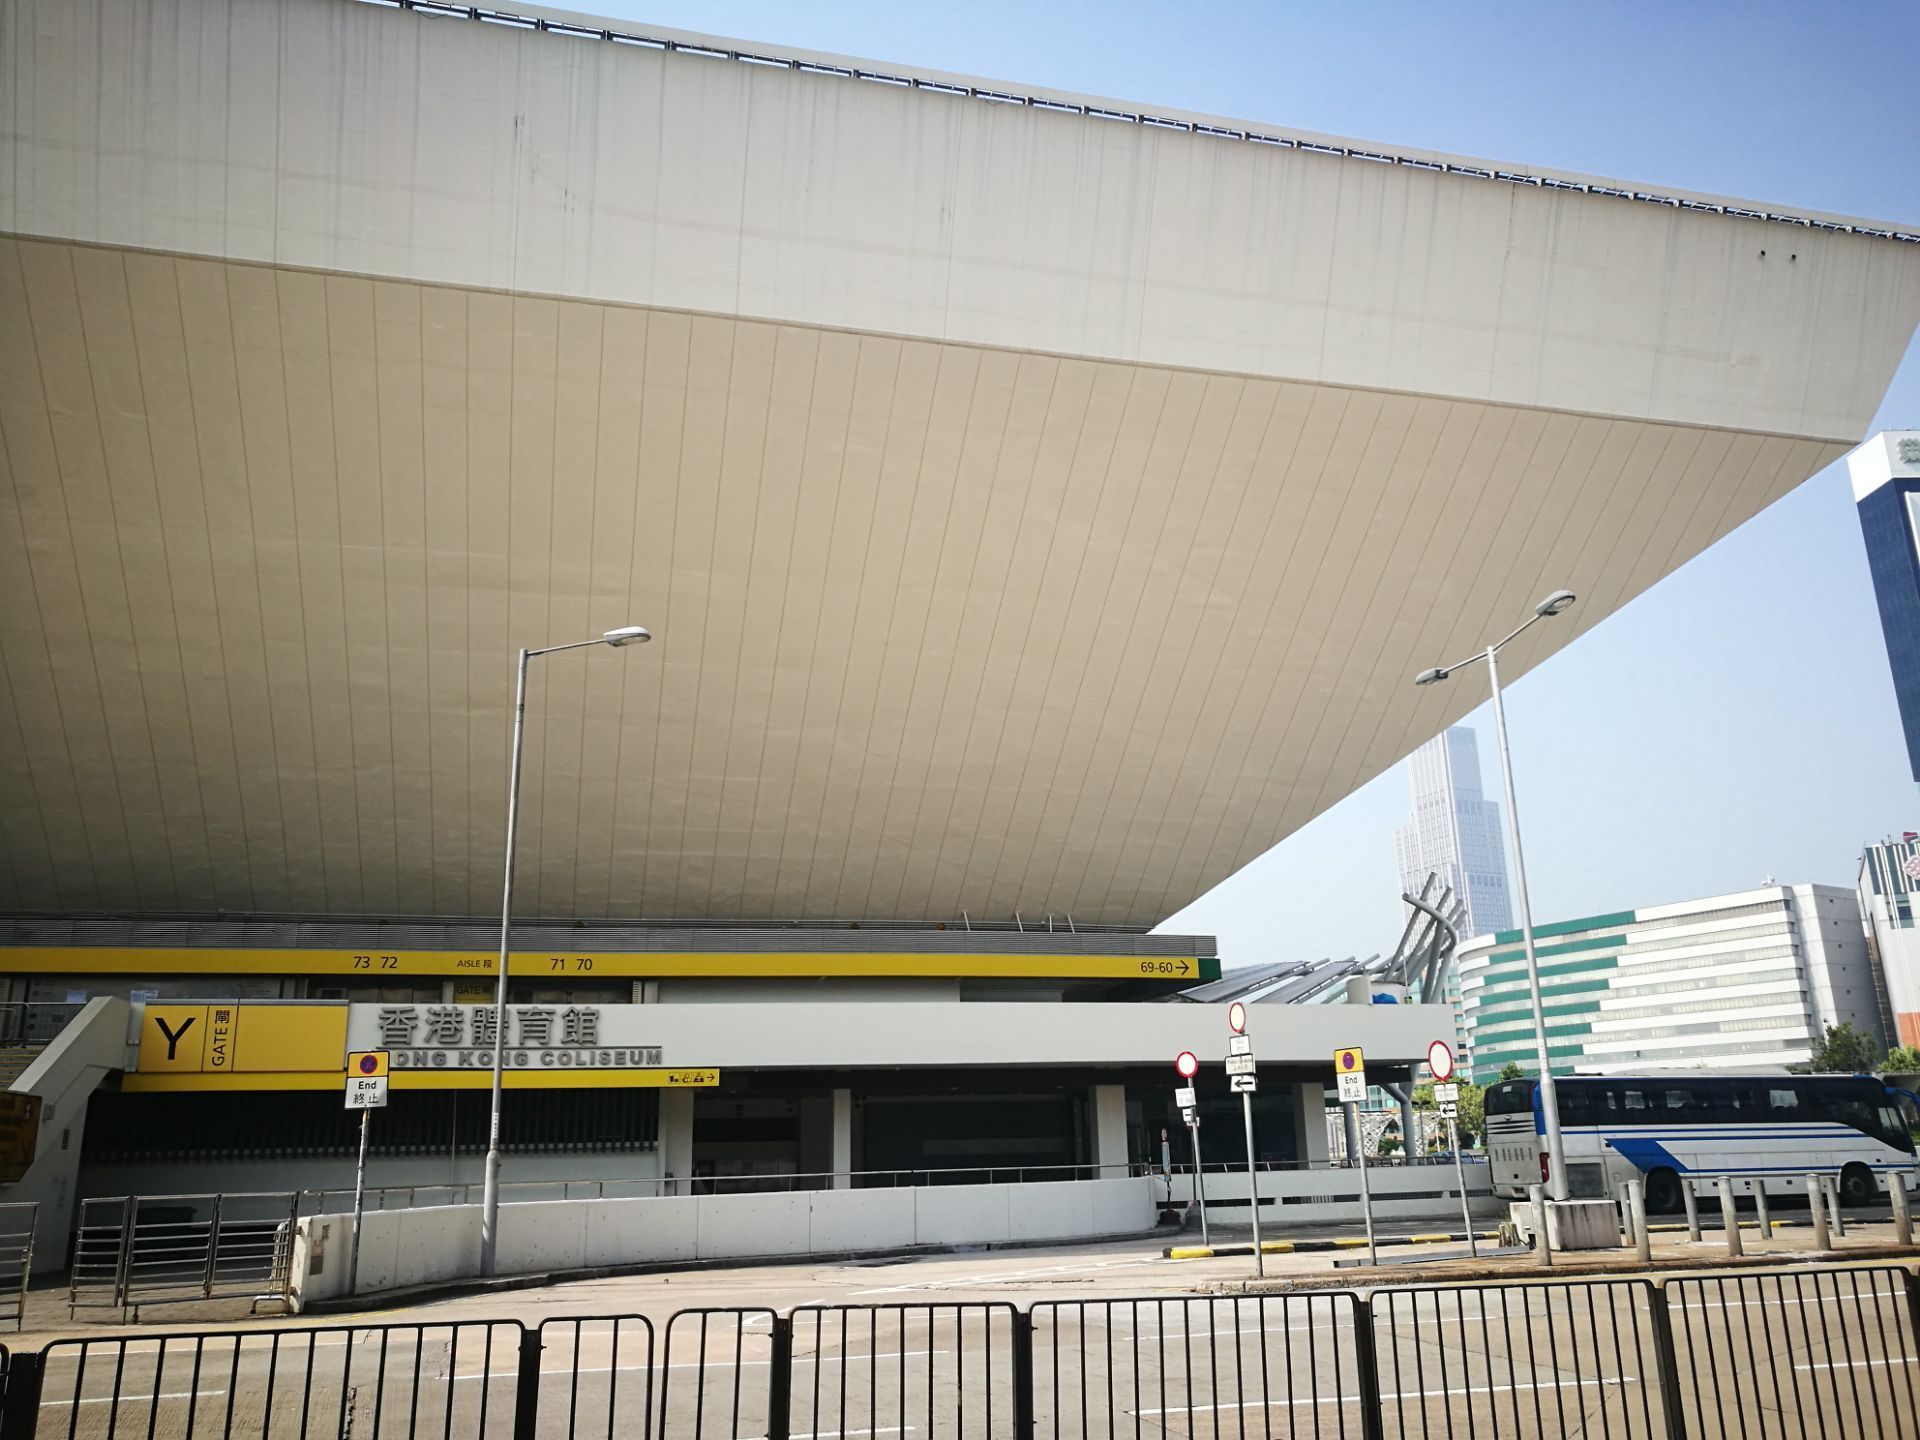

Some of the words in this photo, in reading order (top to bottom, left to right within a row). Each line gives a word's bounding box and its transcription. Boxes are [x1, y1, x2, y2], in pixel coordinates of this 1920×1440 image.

[353, 956, 370, 969] 73
[380, 956, 398, 969] 72
[457, 959, 481, 968] AISLE
[483, 959, 492, 969] 段
[550, 958, 565, 970] 71
[576, 958, 593, 970] 70
[1140, 961, 1173, 973] 69-60
[456, 984, 481, 995] GATE
[215, 1010, 230, 1024] 閘
[378, 1006, 599, 1045] 香港體育館
[155, 1017, 197, 1060] Y
[212, 1028, 228, 1067] GATE
[395, 1050, 447, 1066] ONG
[540, 1050, 663, 1066] COLISEUM
[358, 1081, 377, 1090] End
[1344, 1075, 1358, 1085] End
[353, 1092, 379, 1105] 終止
